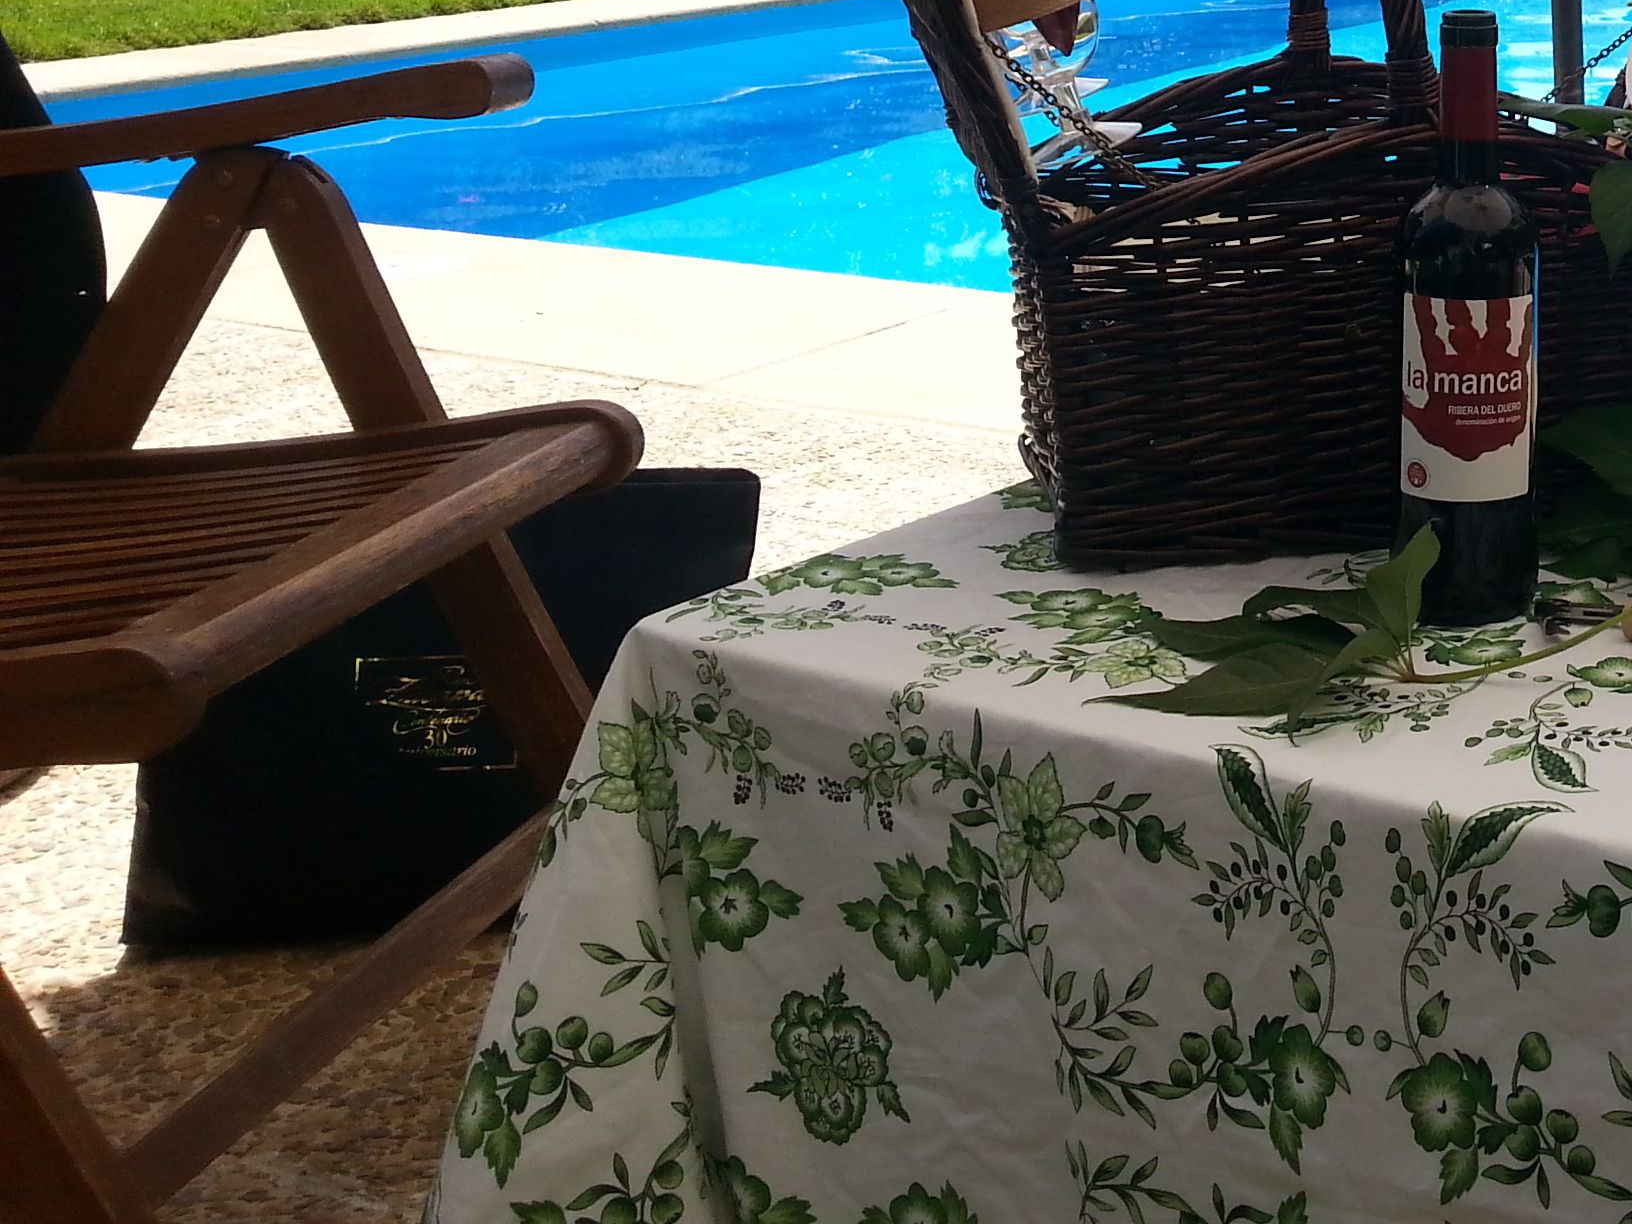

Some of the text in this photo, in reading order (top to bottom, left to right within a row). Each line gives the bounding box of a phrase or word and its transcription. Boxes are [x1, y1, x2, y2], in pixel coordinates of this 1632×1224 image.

[1407, 360, 1522, 395] la manca
[1448, 401, 1522, 415] RIBERA DEL DUERO
[424, 728, 448, 749] 30
